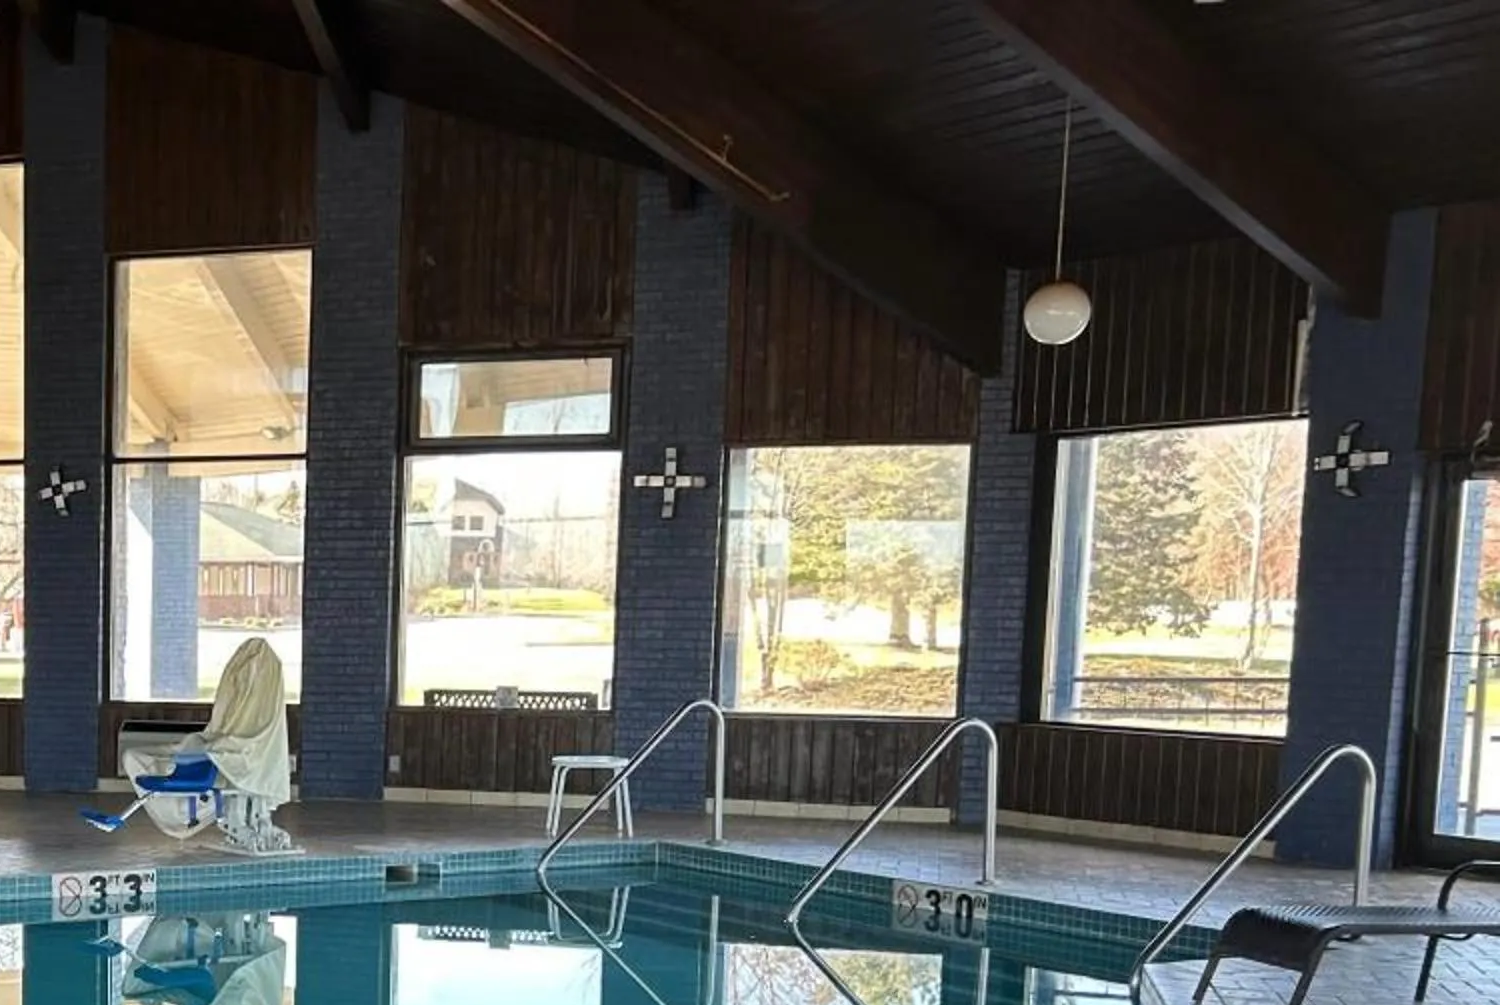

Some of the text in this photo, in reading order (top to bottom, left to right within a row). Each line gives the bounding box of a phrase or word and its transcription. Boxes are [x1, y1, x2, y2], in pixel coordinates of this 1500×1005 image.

[89, 875, 107, 898] 3
[123, 873, 142, 896] 3
[925, 889, 941, 914] 3
[956, 893, 973, 920] 0
